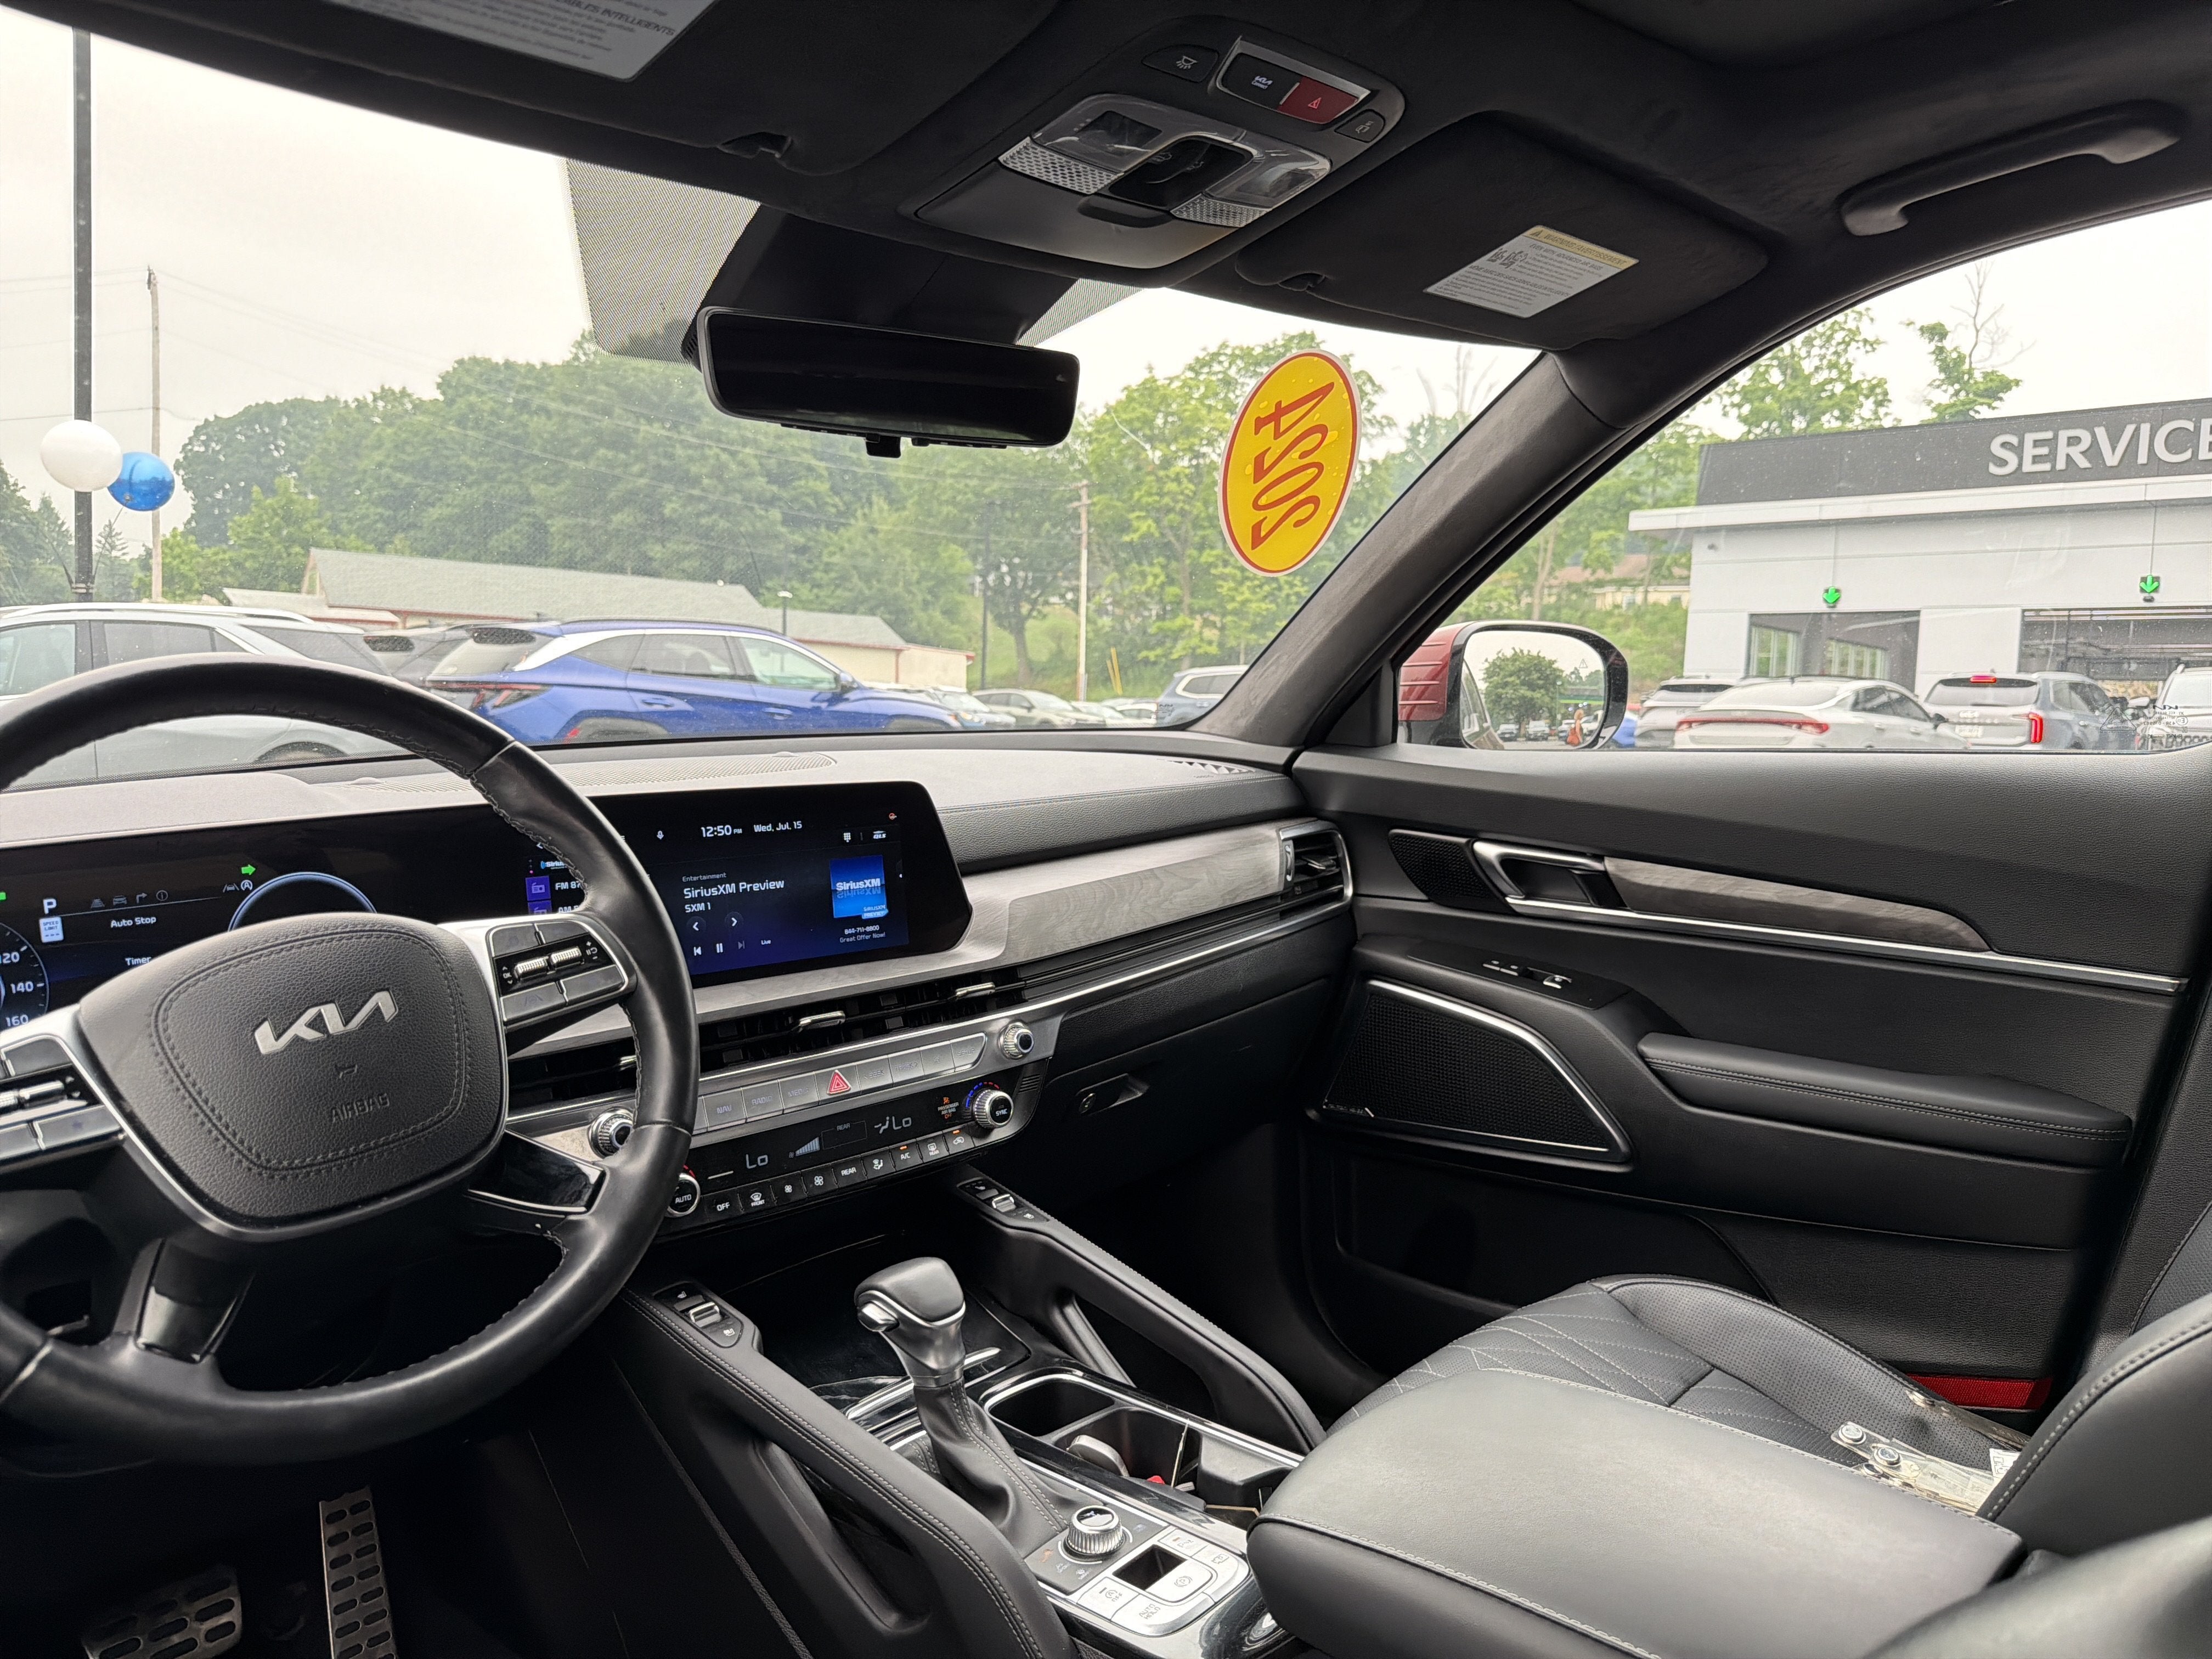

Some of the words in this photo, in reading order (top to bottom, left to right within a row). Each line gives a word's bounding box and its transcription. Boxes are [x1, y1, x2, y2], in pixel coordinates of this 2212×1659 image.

[701, 825, 732, 837] 12:50
[793, 821, 802, 829] 15
[682, 872, 726, 882] Entertainment
[555, 882, 568, 890] FM
[684, 883, 736, 899] SiriusXM
[739, 879, 785, 893] Preview
[836, 878, 881, 891] SiriusXM
[43, 898, 57, 915] P
[685, 902, 706, 913] SXM
[707, 902, 712, 910] 1
[110, 919, 133, 928] Auto
[135, 916, 156, 925] Stop
[844, 924, 879, 934] 844-711-8800
[856, 933, 871, 941] Offer
[125, 956, 152, 966] Timer
[10, 981, 34, 994] 140
[5, 1014, 29, 1027] 160
[255, 990, 399, 1055] KIA
[751, 1096, 773, 1106] RADIO
[331, 1092, 390, 1124] AIRBAG
[716, 1104, 732, 1114] NAV
[938, 1102, 959, 1111] PASSENGER
[996, 1108, 1008, 1116] SYNC
[837, 1122, 850, 1131] REAR
[892, 1116, 912, 1131] Lo
[900, 1152, 911, 1160] A/C
[746, 1154, 769, 1169] Lo
[841, 1167, 856, 1176] REAR
[675, 1194, 692, 1204] AUTO
[751, 1199, 765, 1207] FRONT
[716, 1201, 730, 1211] OFF
[1138, 1603, 1156, 1617] AUTO
[1143, 1606, 1161, 1620] HOLD
